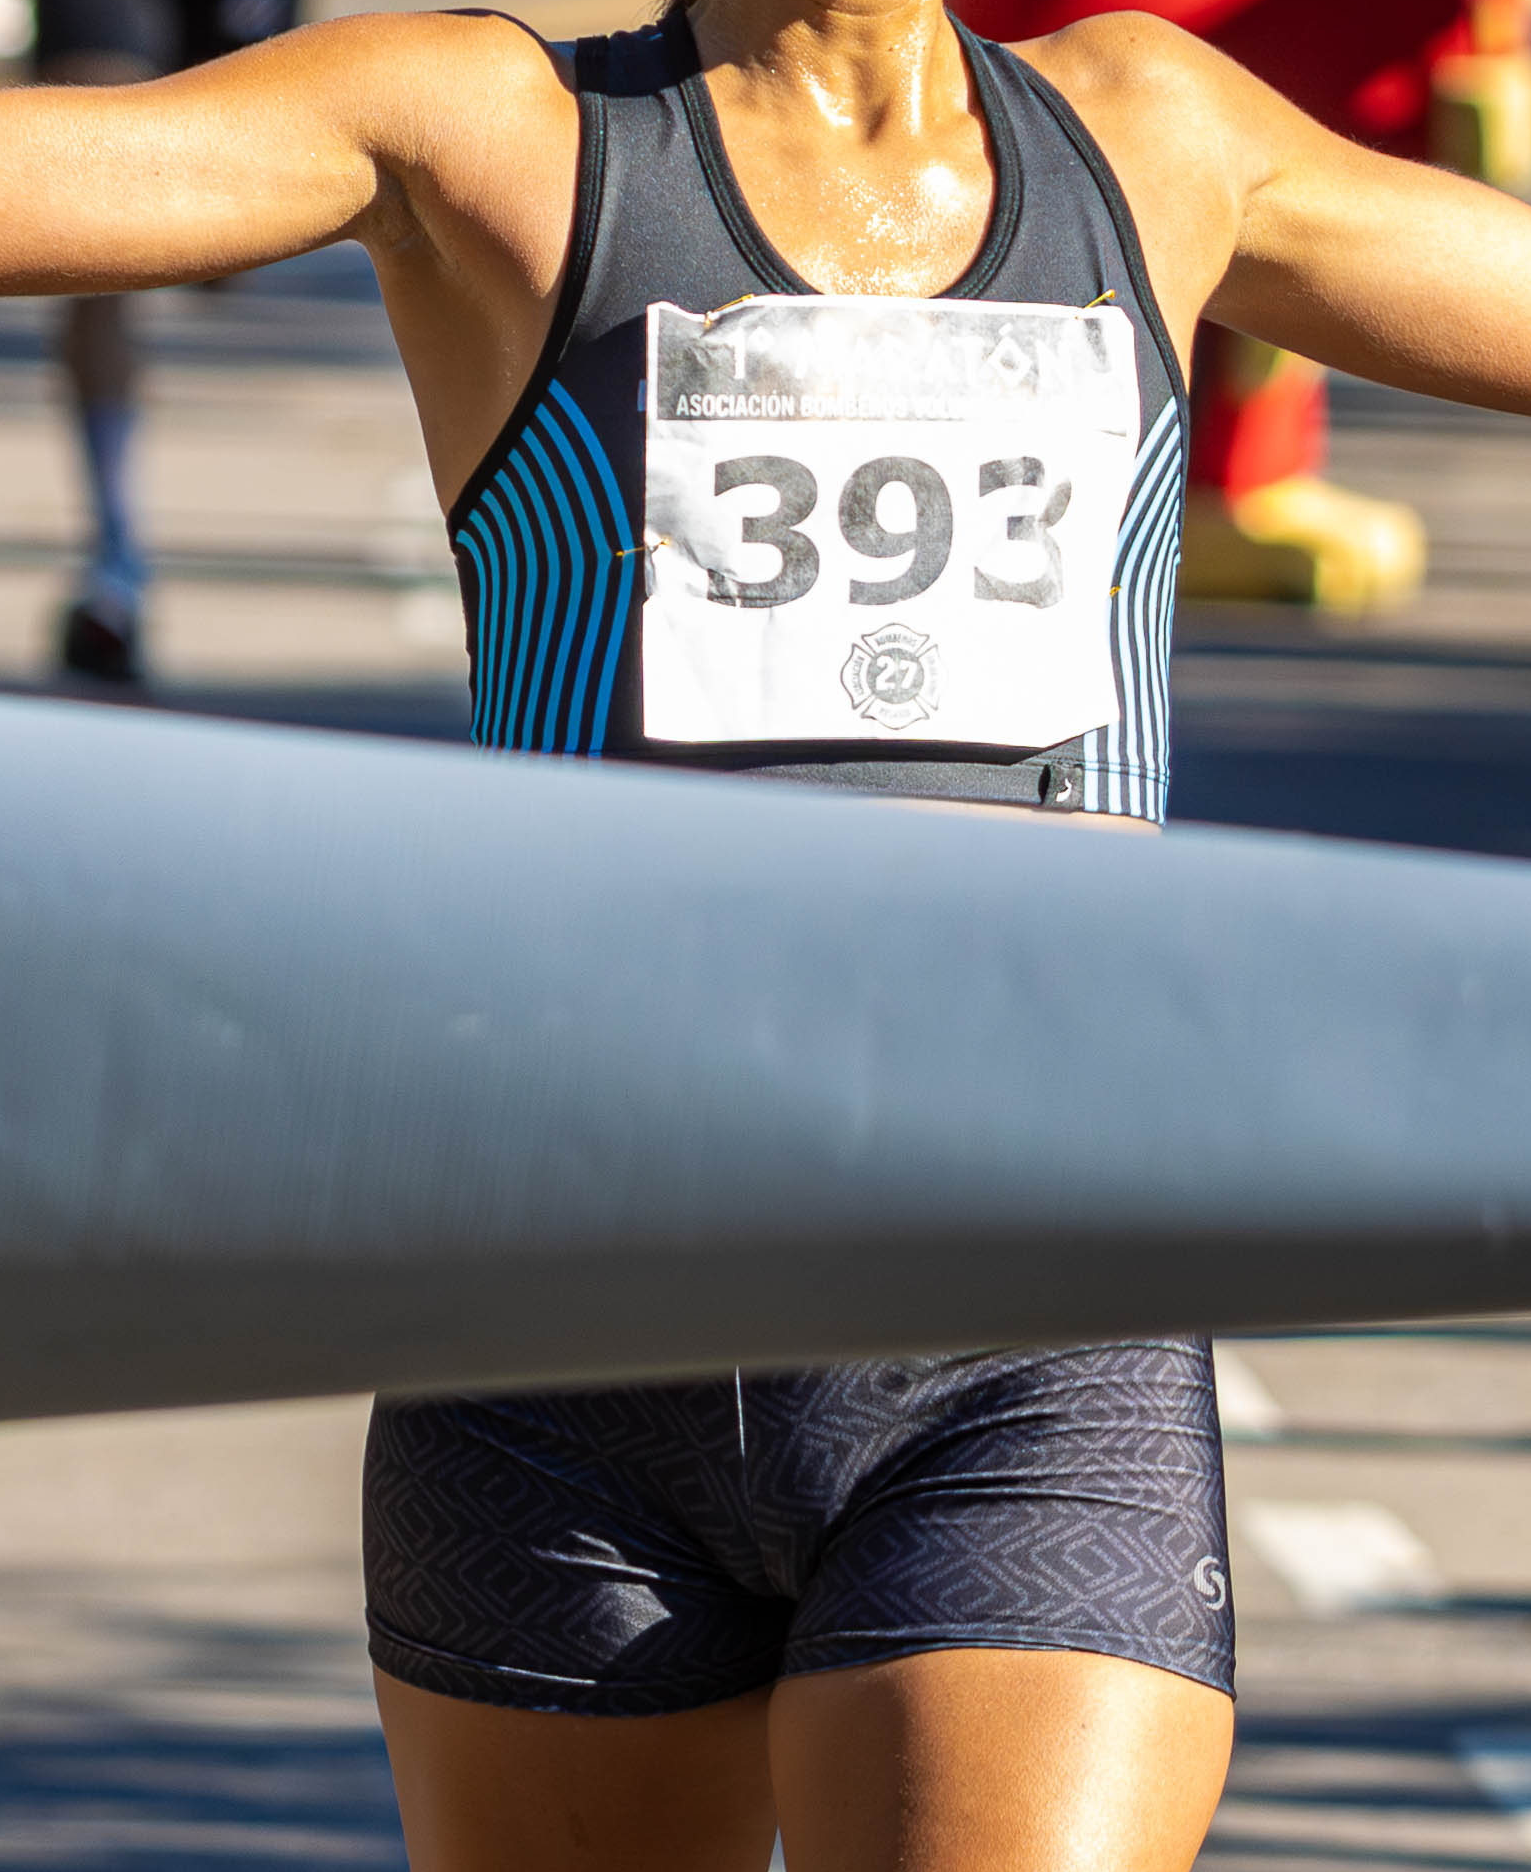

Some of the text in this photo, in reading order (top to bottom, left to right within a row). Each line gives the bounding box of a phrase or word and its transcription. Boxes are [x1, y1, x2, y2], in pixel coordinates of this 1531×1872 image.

[675, 389, 796, 419] ASOCIACIÓN
[705, 454, 1073, 610] 393
[875, 654, 918, 691] 27
